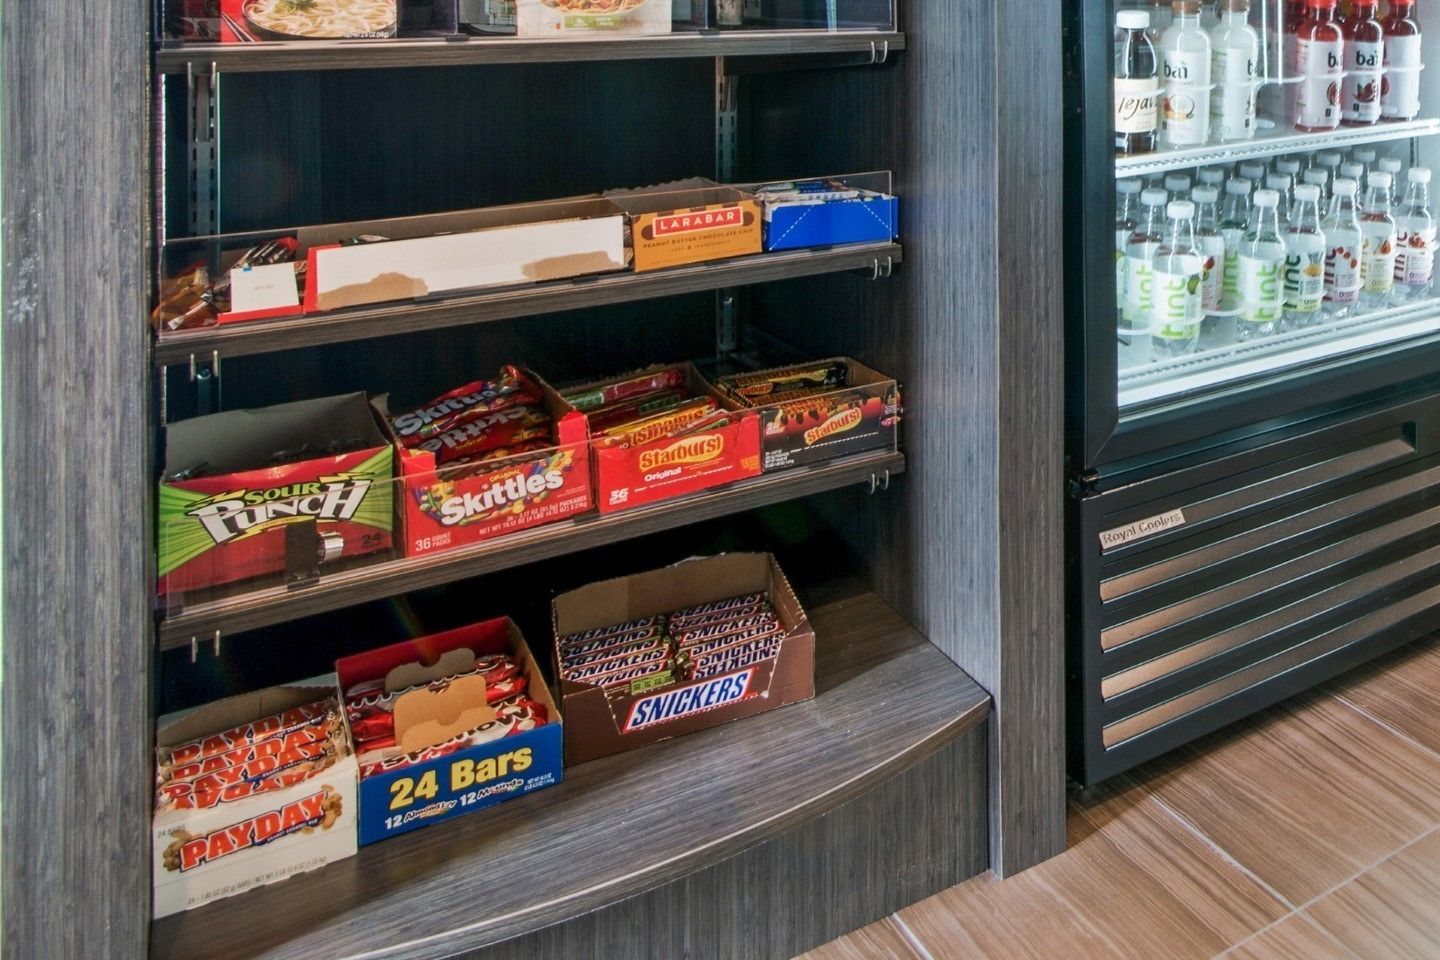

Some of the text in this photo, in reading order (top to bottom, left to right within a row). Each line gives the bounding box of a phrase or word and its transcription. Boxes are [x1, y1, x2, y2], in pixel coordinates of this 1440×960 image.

[659, 210, 736, 231] LARABAR
[806, 409, 861, 443] Starburst
[639, 435, 724, 471] Starburst
[643, 466, 682, 482] Original
[186, 478, 374, 544] PUNCH
[244, 482, 320, 506] SOUR
[440, 469, 565, 526] Skittles
[414, 536, 433, 552] 36
[1103, 513, 1182, 545] Royal Coolers
[683, 611, 774, 642] SNICKERS
[630, 670, 751, 728] SNICKERS
[388, 769, 439, 810] 24
[450, 746, 533, 792] Bars
[384, 814, 404, 830] 12
[458, 790, 477, 808] 12
[181, 793, 328, 872] PAYDAY
